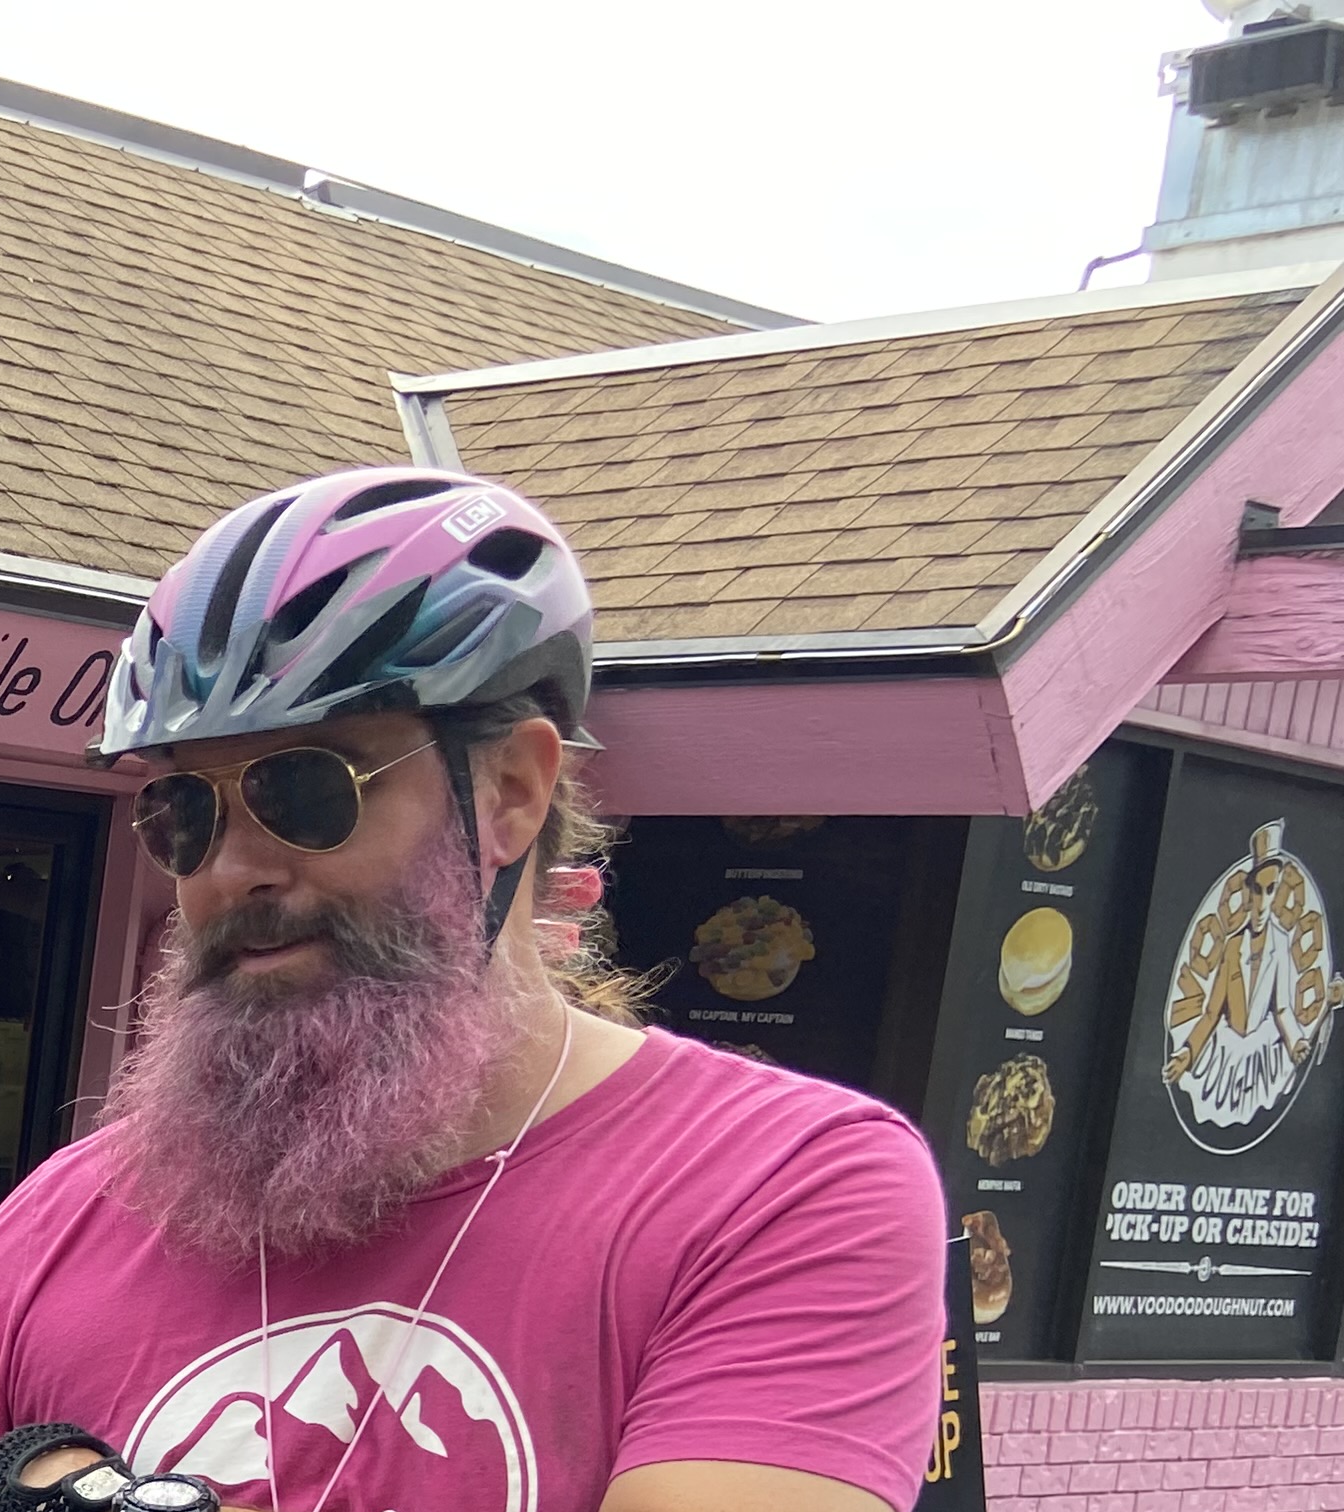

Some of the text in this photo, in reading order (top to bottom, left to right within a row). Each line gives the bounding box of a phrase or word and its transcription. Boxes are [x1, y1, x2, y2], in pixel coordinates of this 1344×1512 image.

[1170, 861, 1325, 1030] VOODOO
[1112, 1181, 1315, 1218] ORDER ONLINE FOR
[1191, 1215, 1223, 1244] OR
[1226, 1217, 1320, 1248] CARSIDE!
[1093, 1295, 1296, 1317] WWW.VOODOODOUGHNUT.COM
